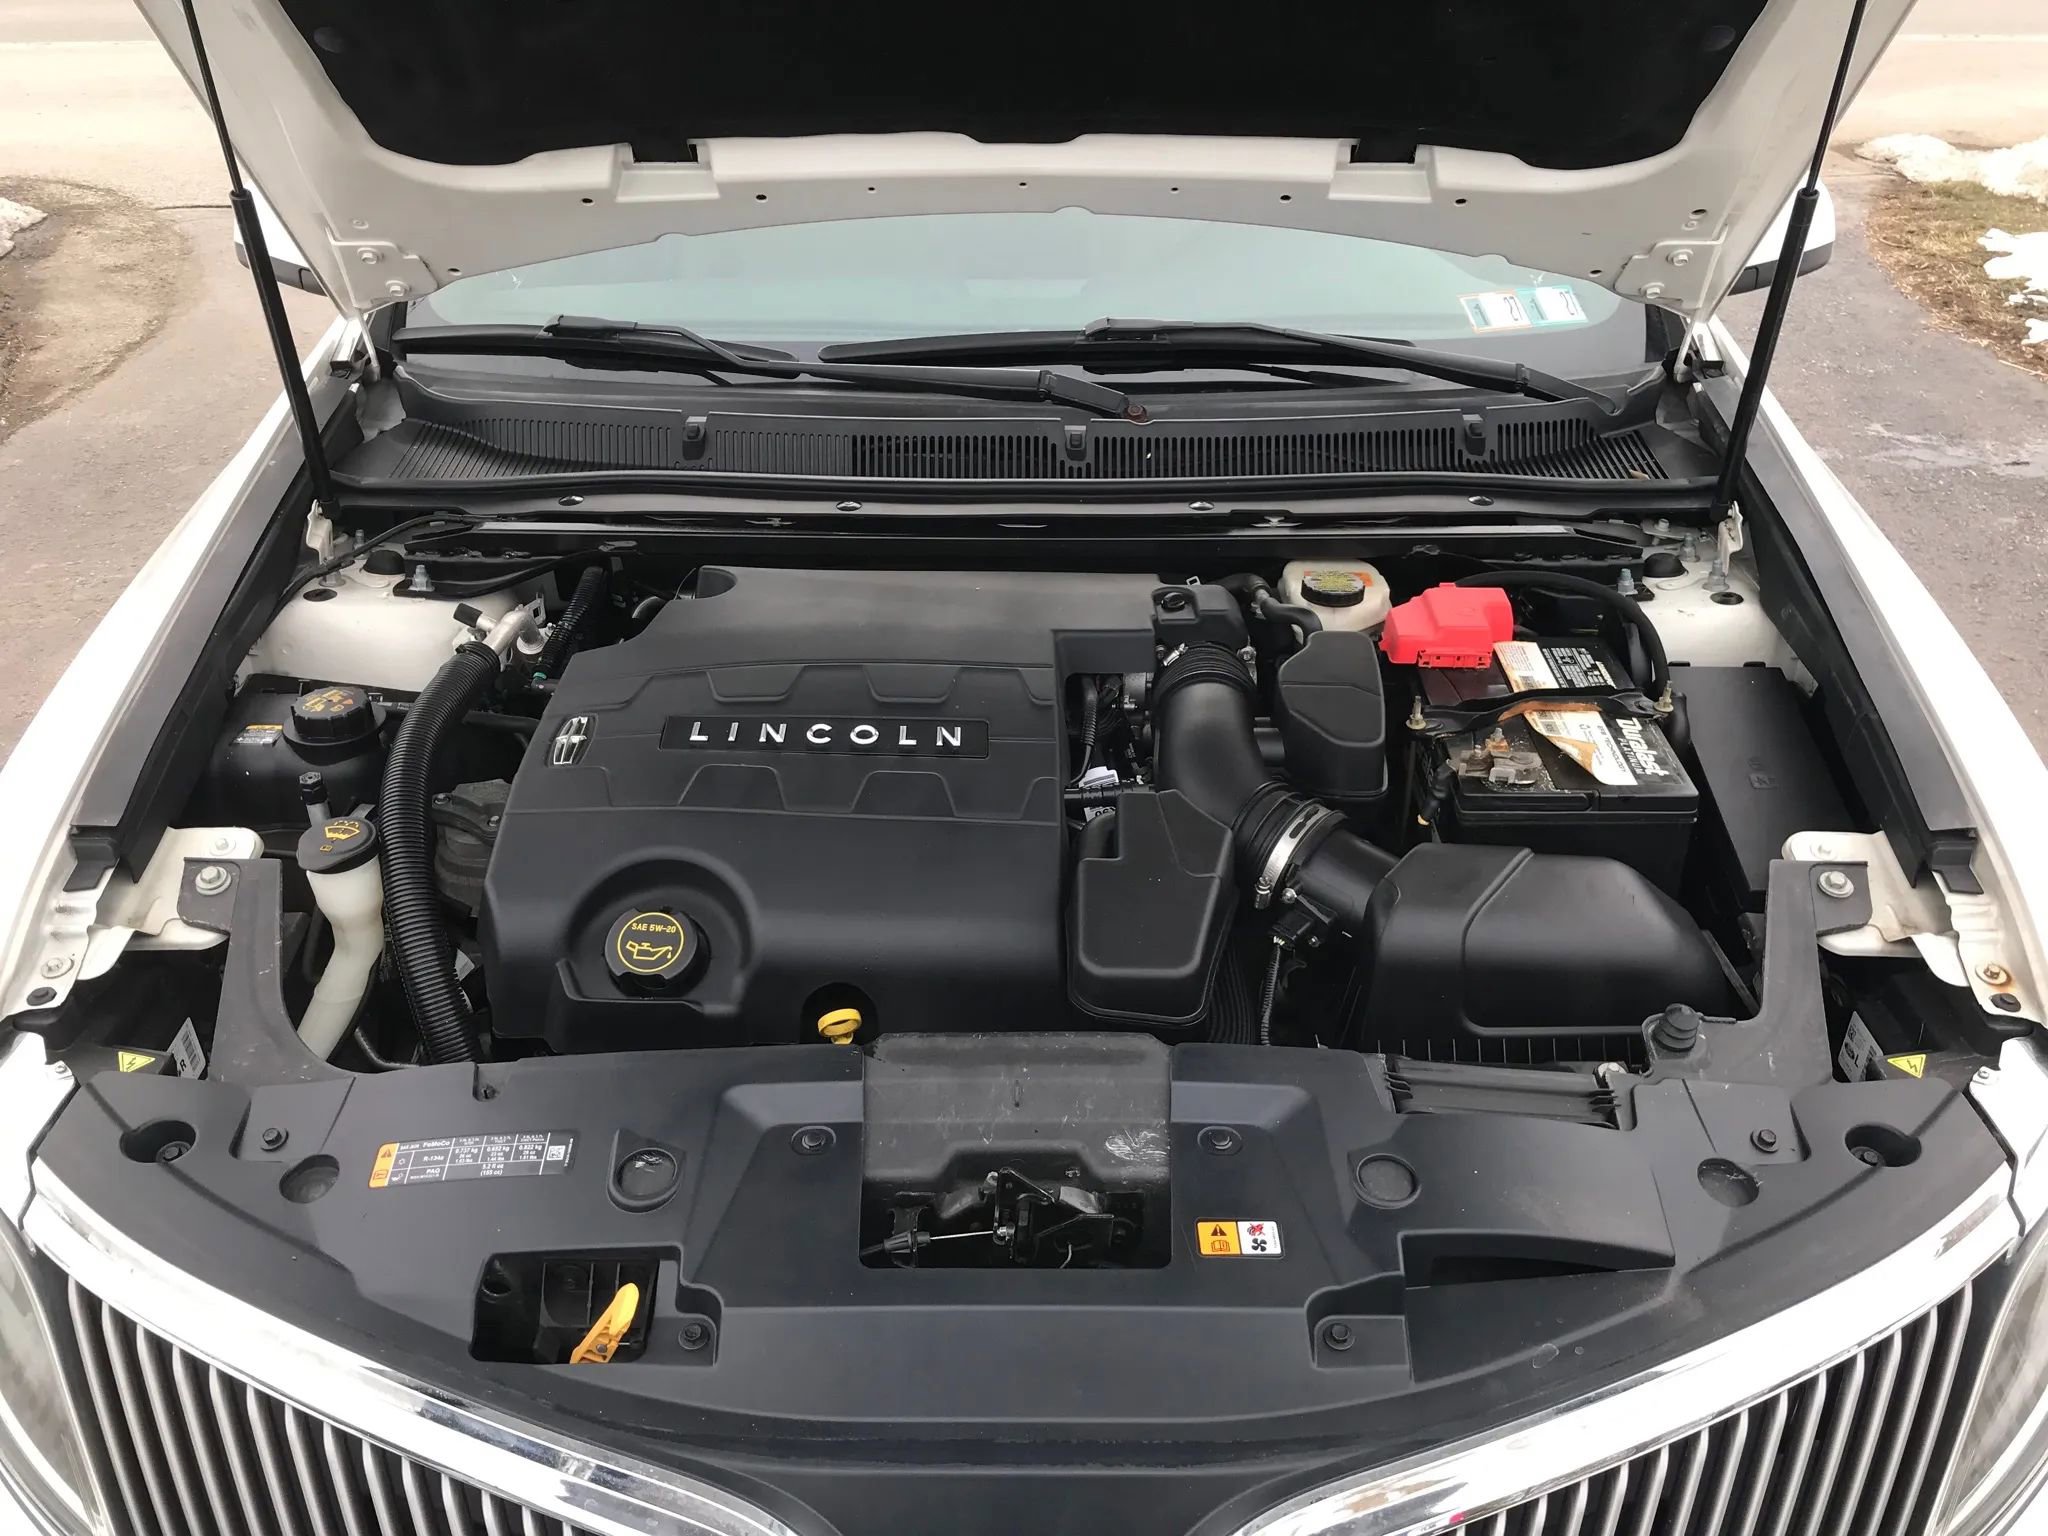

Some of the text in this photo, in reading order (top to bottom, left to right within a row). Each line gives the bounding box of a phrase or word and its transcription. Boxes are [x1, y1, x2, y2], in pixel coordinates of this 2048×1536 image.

[689, 721, 962, 747] LINCOLN
[1616, 717, 1670, 776] Duralast
[1617, 737, 1645, 775] PLATINUM
[632, 923, 676, 933] SAE 5W-20
[423, 1140, 450, 1148] FoMoCo
